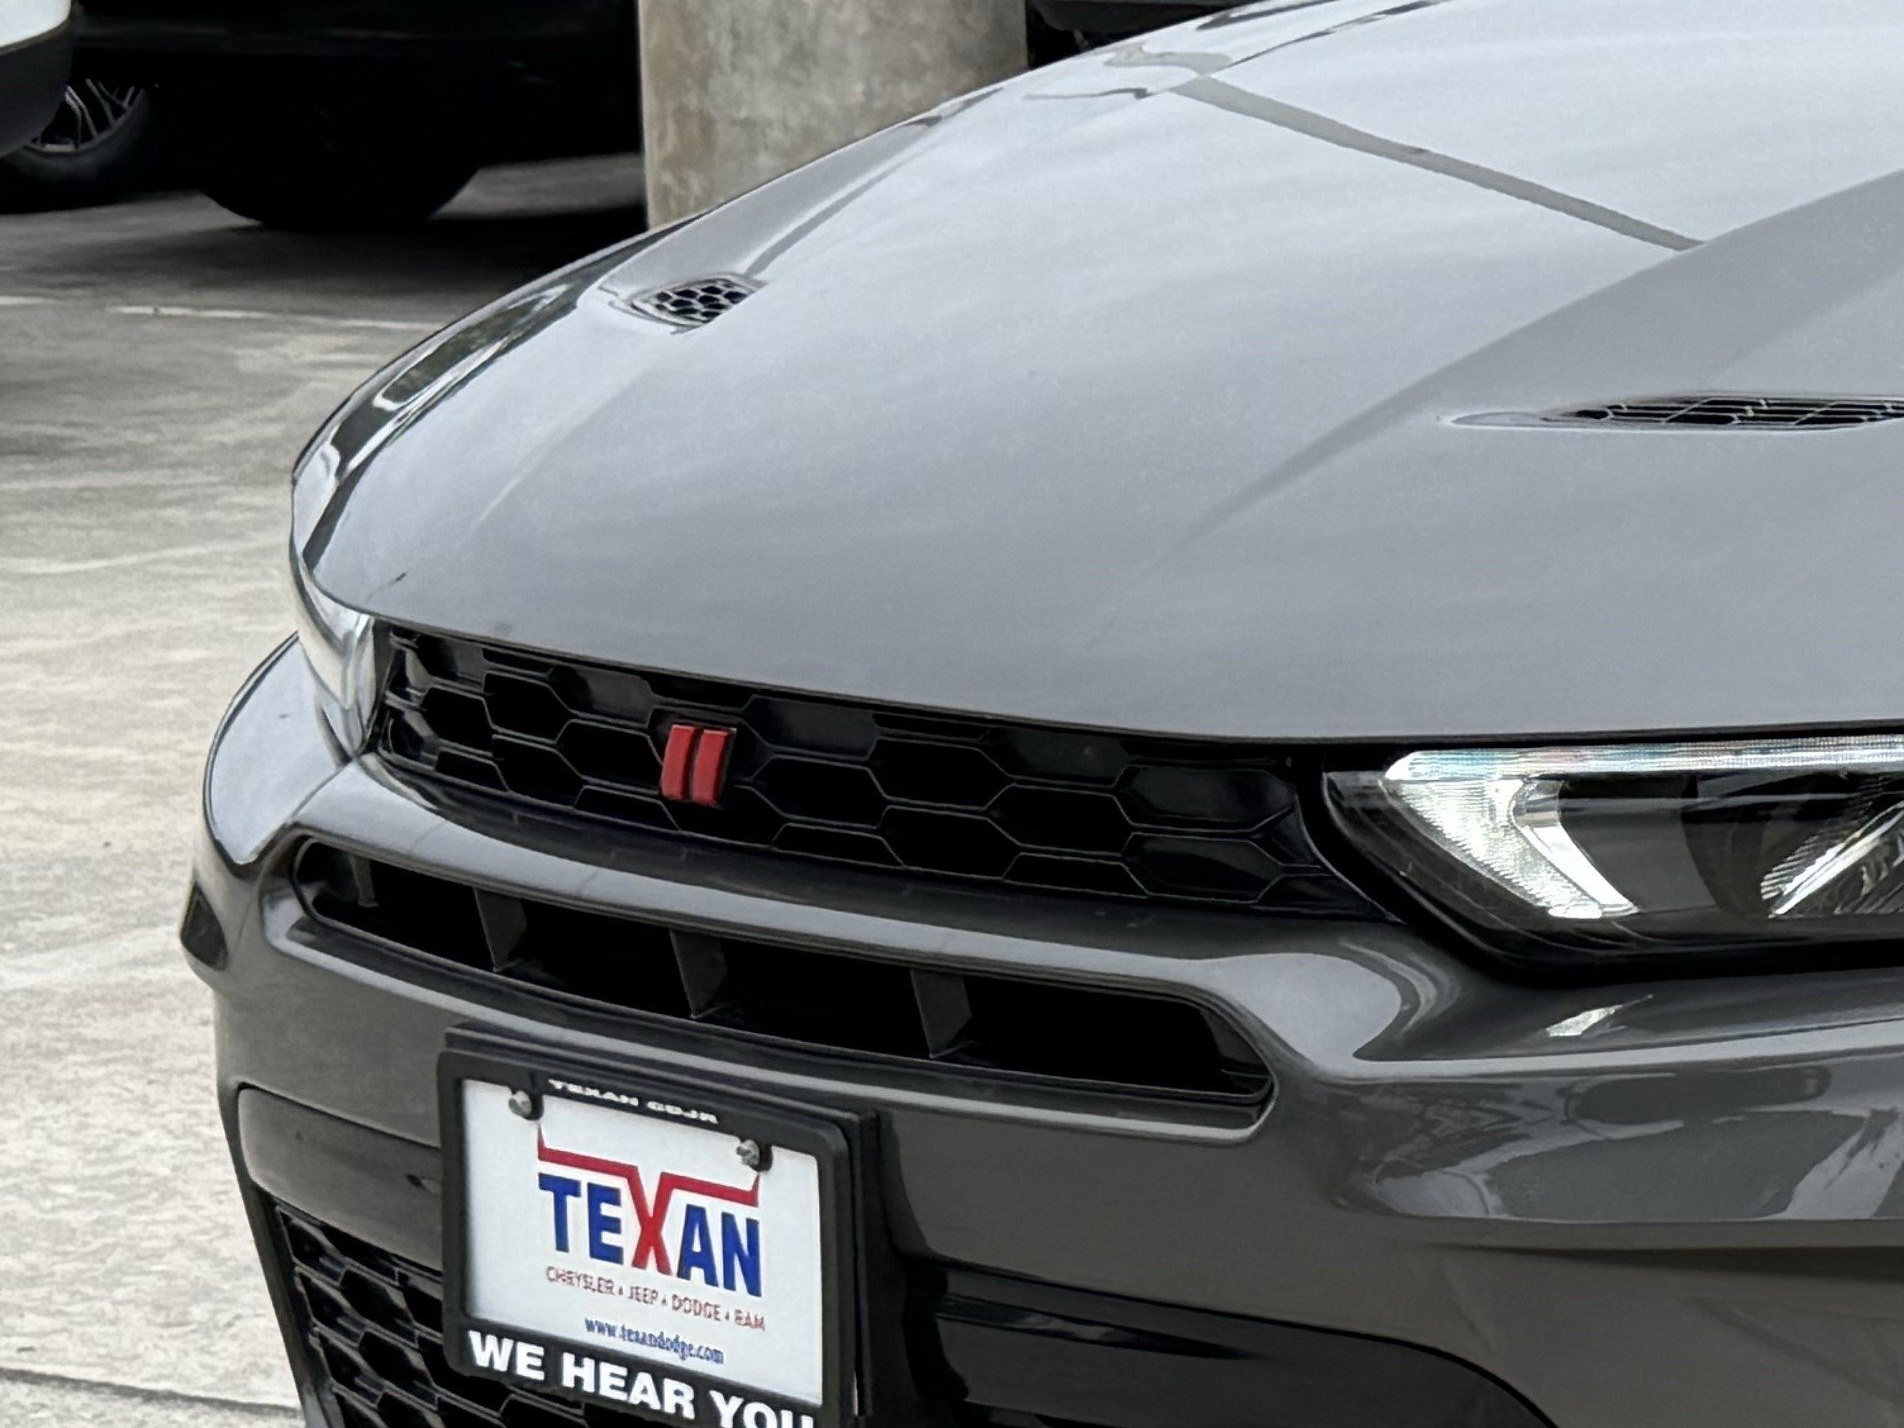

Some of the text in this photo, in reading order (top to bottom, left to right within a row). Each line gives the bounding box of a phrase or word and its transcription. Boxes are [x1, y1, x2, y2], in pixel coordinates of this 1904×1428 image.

[547, 1078, 639, 1107] TEXAN
[537, 1122, 763, 1298] TEXAN
[545, 1265, 767, 1331] CHRYSLER JEEP DODGE RAM
[583, 1317, 725, 1361] www.texandodge.com
[467, 1329, 546, 1381] WE
[561, 1351, 696, 1421] HEAR
